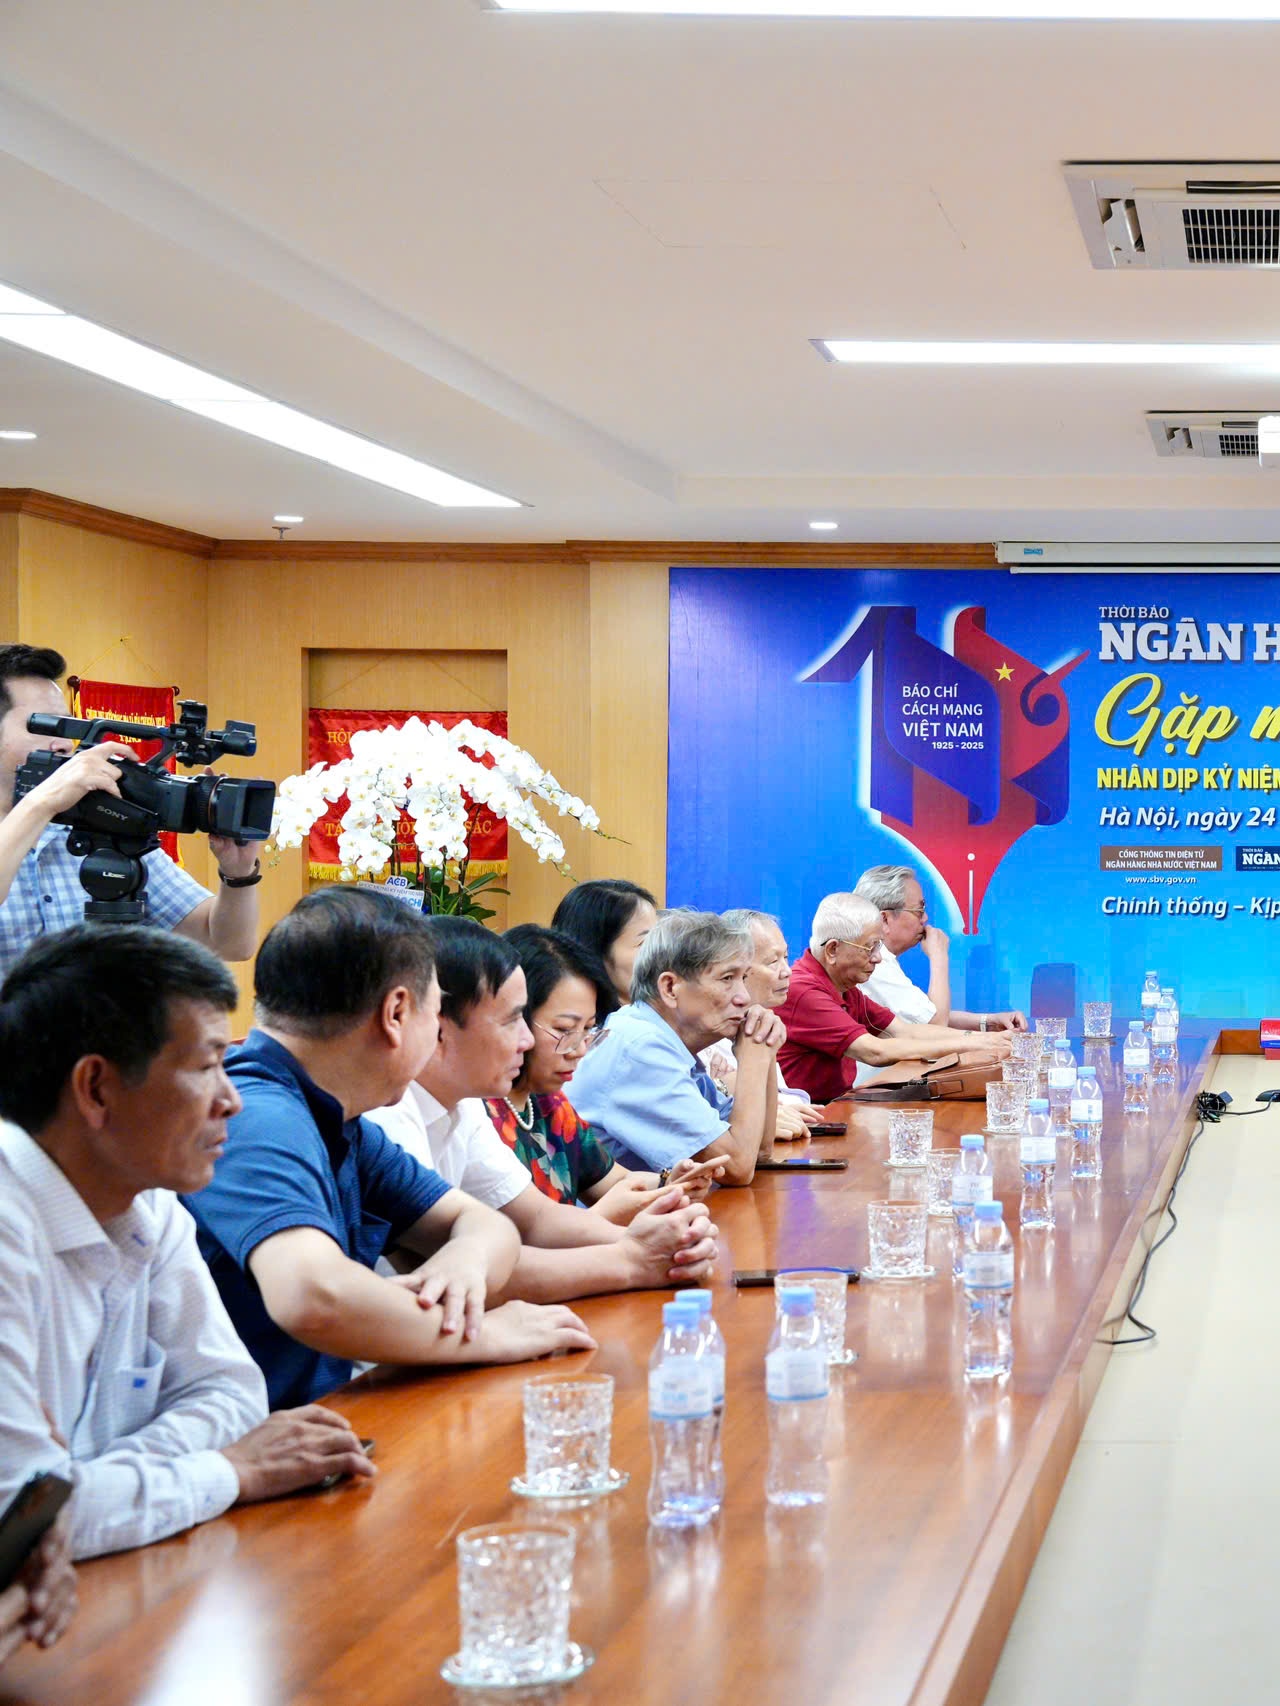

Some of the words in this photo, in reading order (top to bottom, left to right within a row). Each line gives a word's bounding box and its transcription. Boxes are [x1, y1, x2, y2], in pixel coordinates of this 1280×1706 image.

[1099, 604, 1136, 618] THỜI
[1138, 604, 1169, 618] BÁO
[1098, 617, 1244, 661] NGÂN
[902, 683, 931, 698] BÁO
[934, 683, 958, 698] CHÍ
[902, 700, 938, 715] CÁCH
[943, 703, 983, 719] MẠNG
[1094, 672, 1238, 756] Gặp
[902, 719, 940, 741] VIỆT
[945, 722, 983, 737] NAM
[1097, 764, 1158, 789] NHÂN
[1163, 768, 1198, 793] DỊP
[1203, 762, 1233, 789] KỶ
[96, 805, 128, 820] SONY
[1100, 806, 1131, 826] Hà
[1136, 806, 1180, 831] Nội,
[1186, 807, 1242, 832] ngày
[1246, 807, 1276, 826] 24
[1165, 850, 1176, 858] TIN
[1127, 860, 1146, 868] HÀNG
[1147, 860, 1162, 868] NHÀ
[1184, 860, 1199, 870] VIỆT
[387, 876, 406, 887] ACB
[1125, 875, 1197, 885] www.sbv.gov.vn
[1101, 896, 1160, 914] Chính
[1167, 896, 1227, 918] thống
